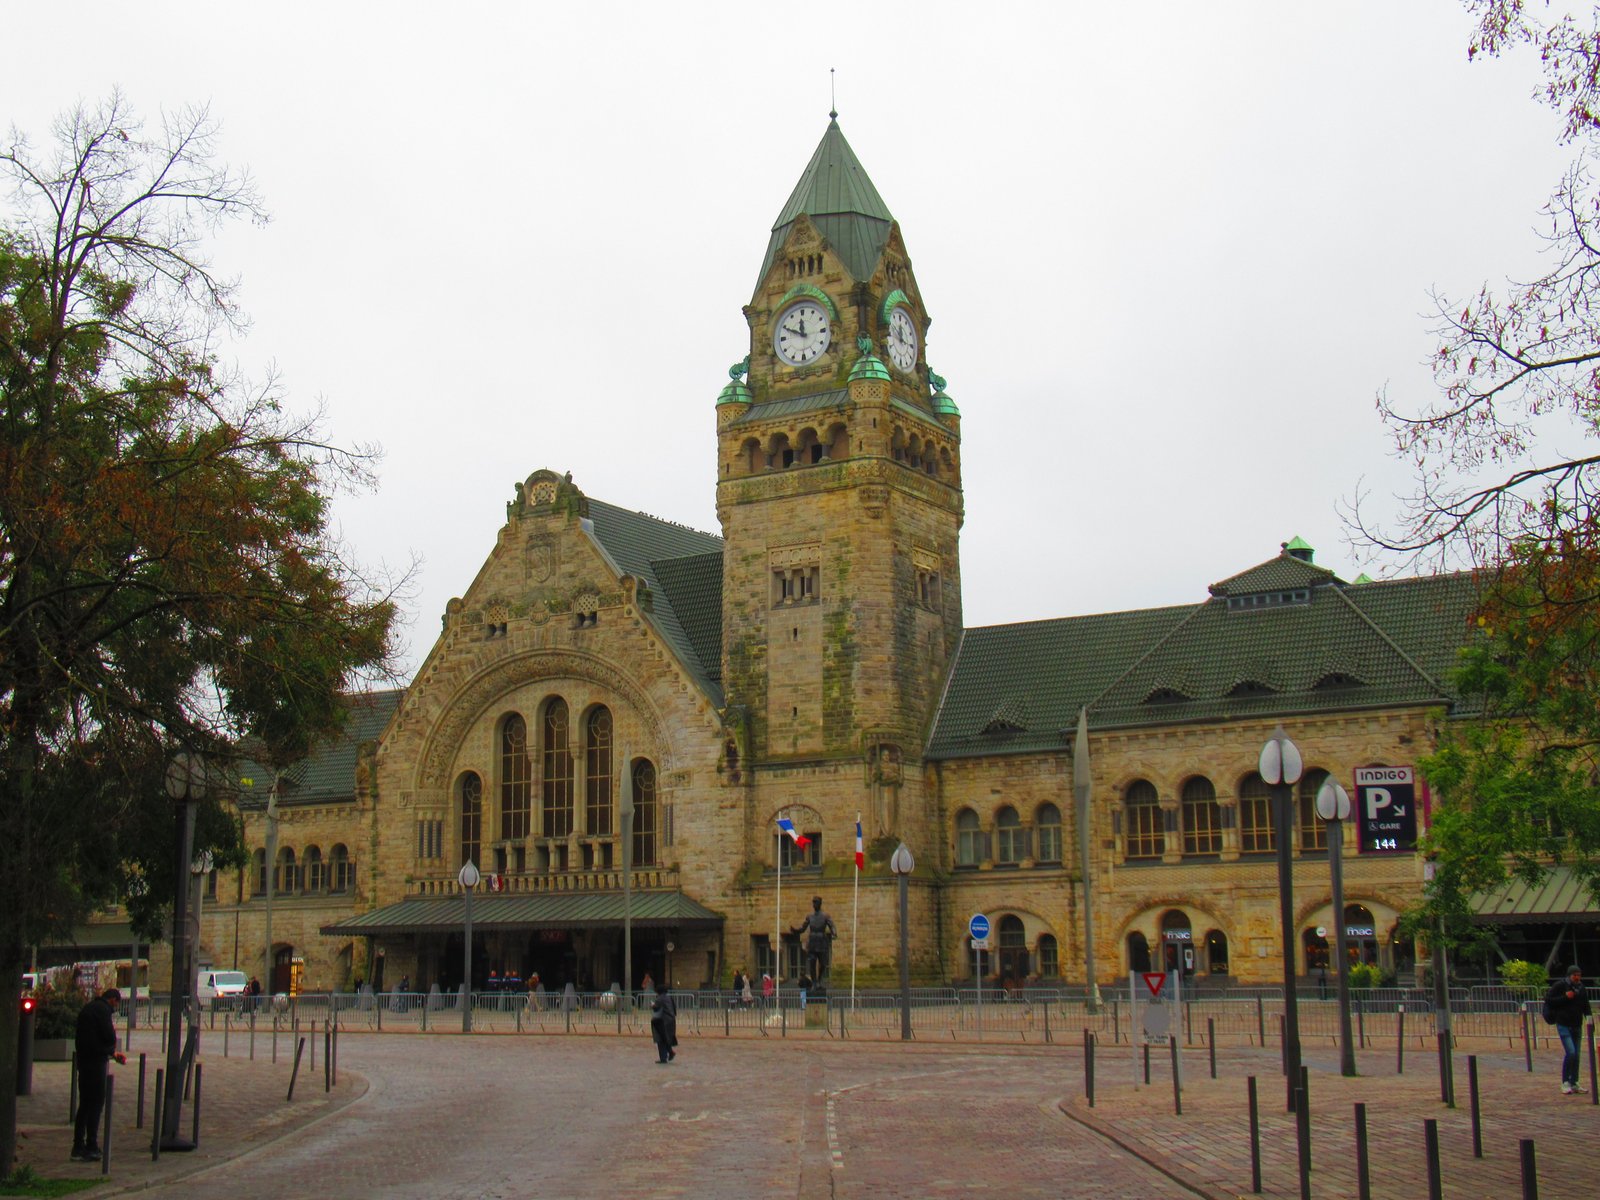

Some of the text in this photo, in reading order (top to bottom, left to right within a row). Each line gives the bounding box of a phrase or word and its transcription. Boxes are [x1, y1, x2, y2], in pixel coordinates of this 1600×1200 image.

[1360, 770, 1407, 780] INDIGO
[1366, 787, 1392, 819] P
[1379, 822, 1401, 830] GARE
[1374, 839, 1397, 850] 144
[1167, 930, 1191, 939] fnac
[1346, 926, 1373, 936] fnac
